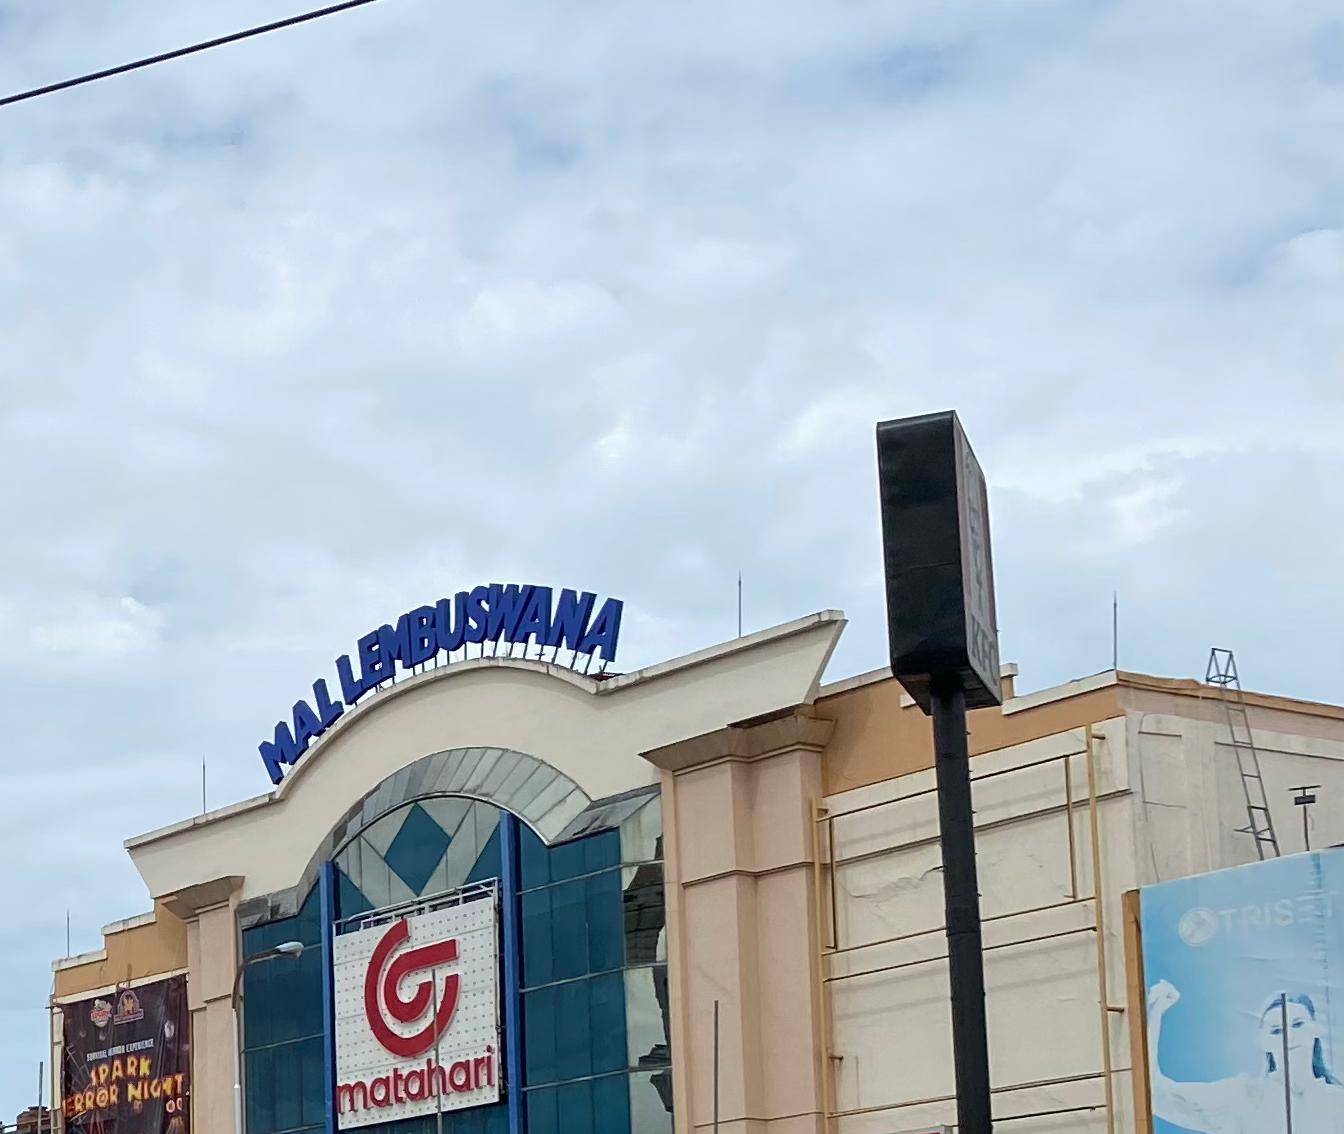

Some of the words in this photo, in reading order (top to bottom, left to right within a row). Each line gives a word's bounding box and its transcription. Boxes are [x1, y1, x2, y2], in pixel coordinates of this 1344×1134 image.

[258, 678, 344, 785] MAL
[336, 583, 623, 706] LEMBUSWANA
[336, 1044, 496, 1115] matahari
